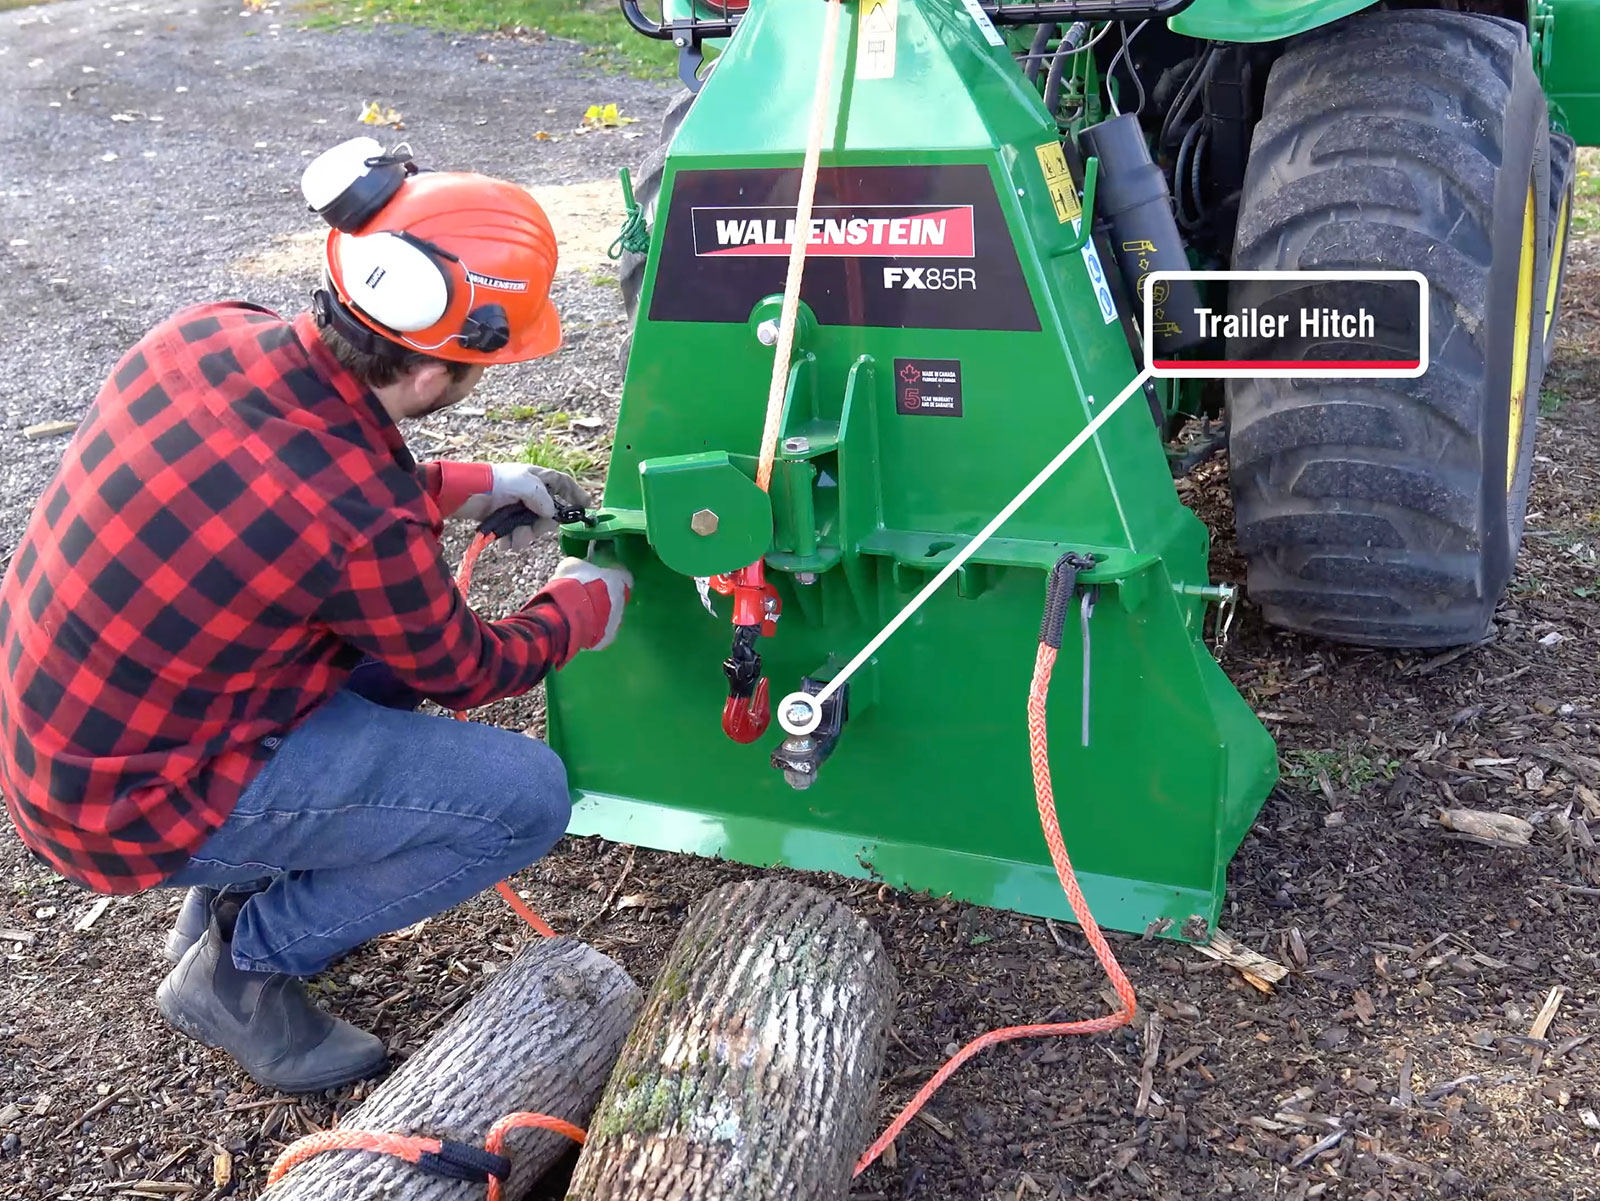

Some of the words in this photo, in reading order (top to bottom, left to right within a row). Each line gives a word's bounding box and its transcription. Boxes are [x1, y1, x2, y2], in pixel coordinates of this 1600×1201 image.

[716, 218, 946, 245] WALLENSTEIN
[470, 273, 526, 290] WALLENSTEIN
[883, 267, 977, 290] FX85R
[904, 388, 921, 409] 5
